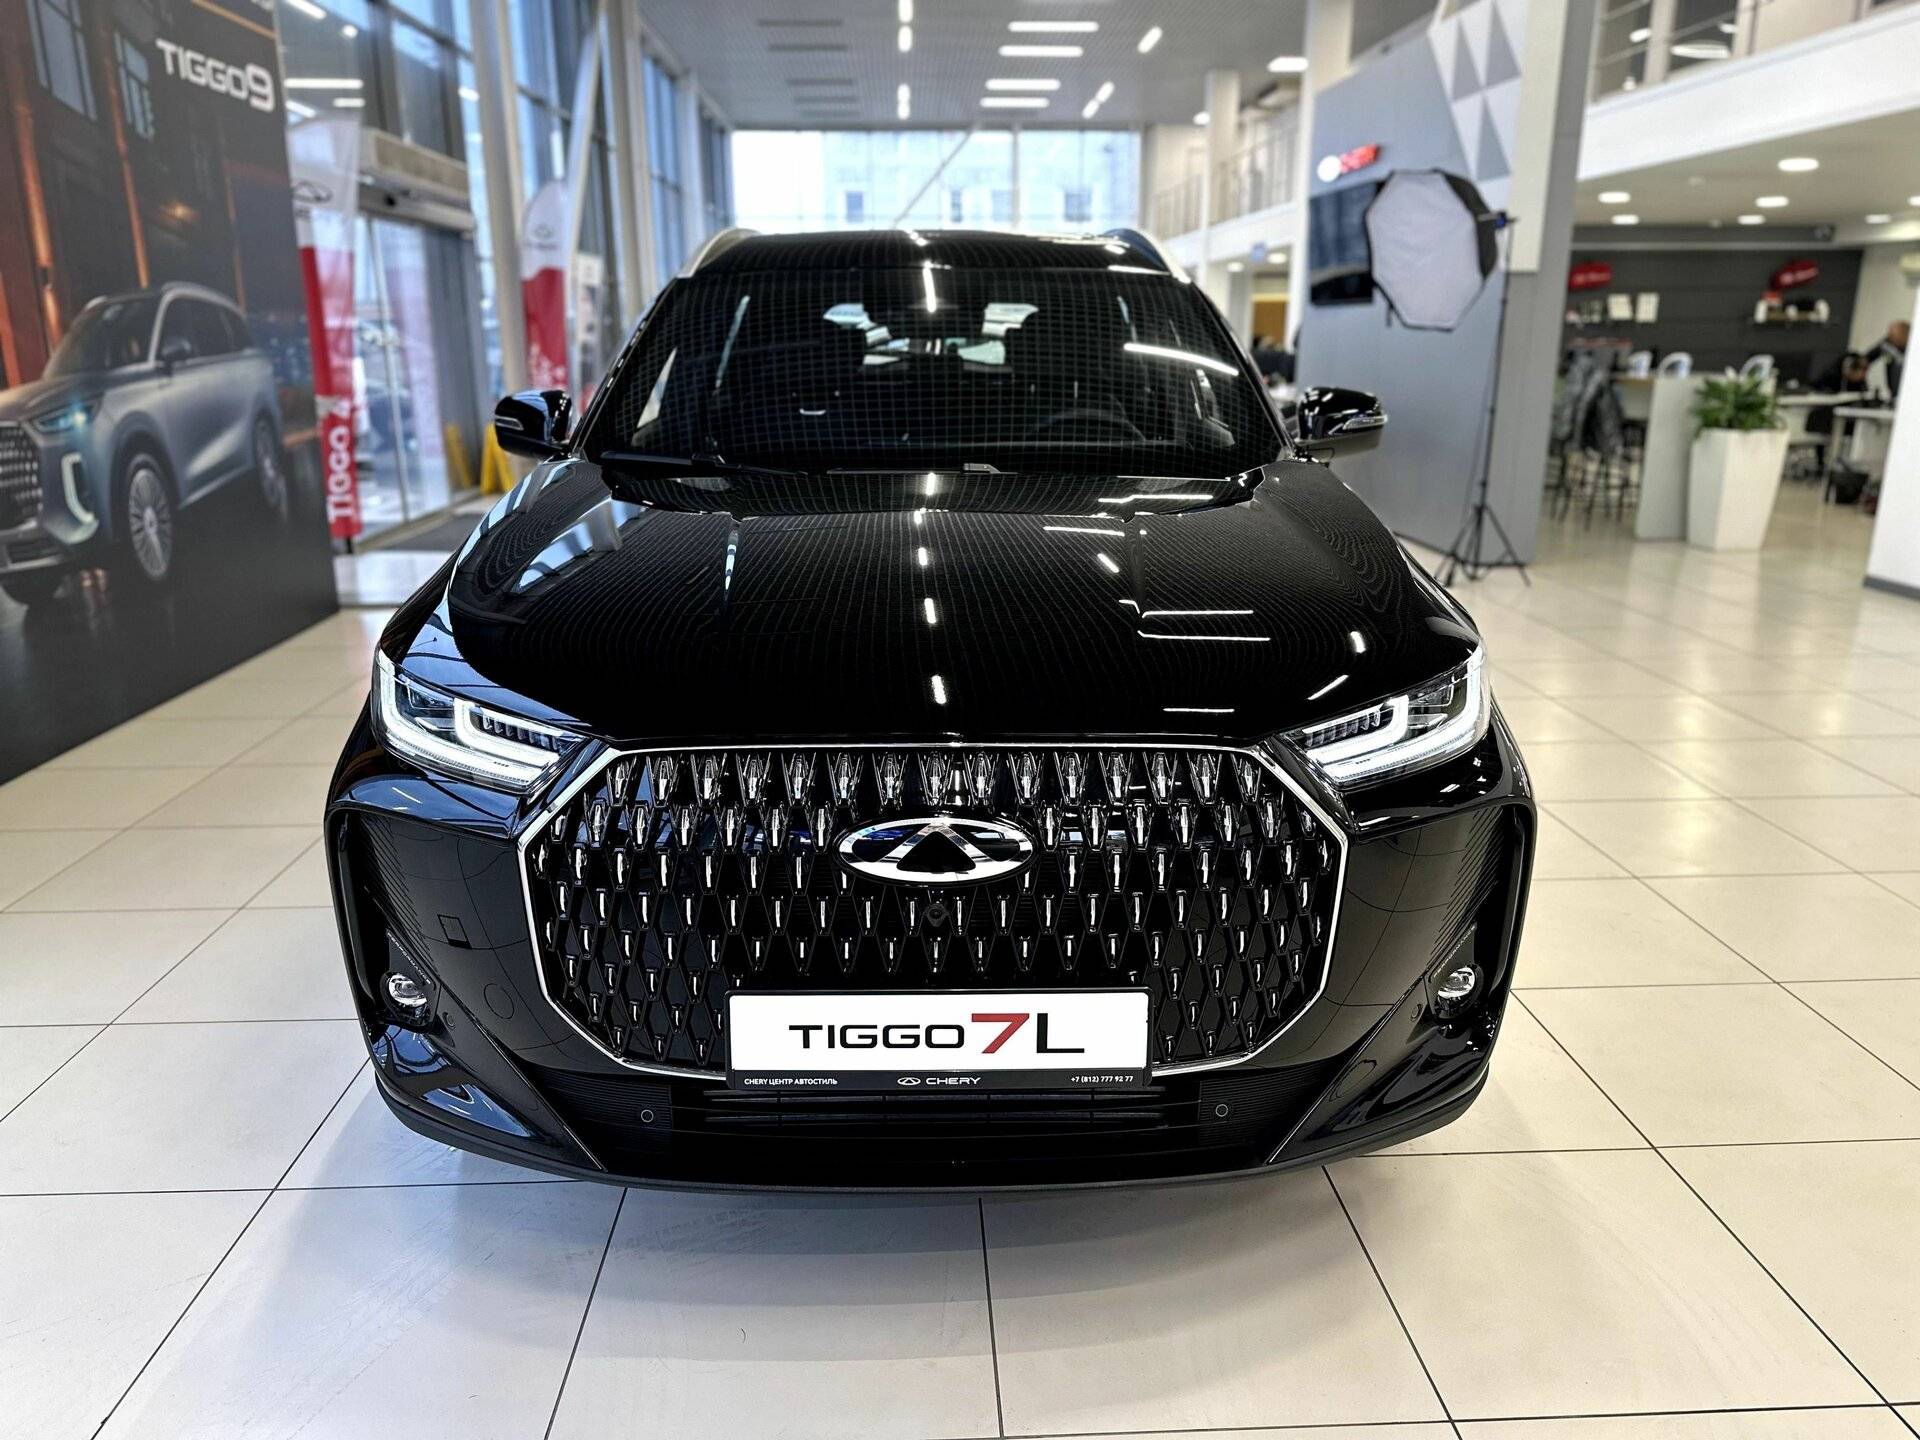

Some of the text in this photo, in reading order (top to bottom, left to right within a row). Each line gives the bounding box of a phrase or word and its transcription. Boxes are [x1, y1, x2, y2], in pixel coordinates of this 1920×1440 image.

[769, 1078, 794, 1086] ЦЕНТР
[926, 1077, 981, 1085] CHERY
[1081, 1075, 1099, 1083] (812)
